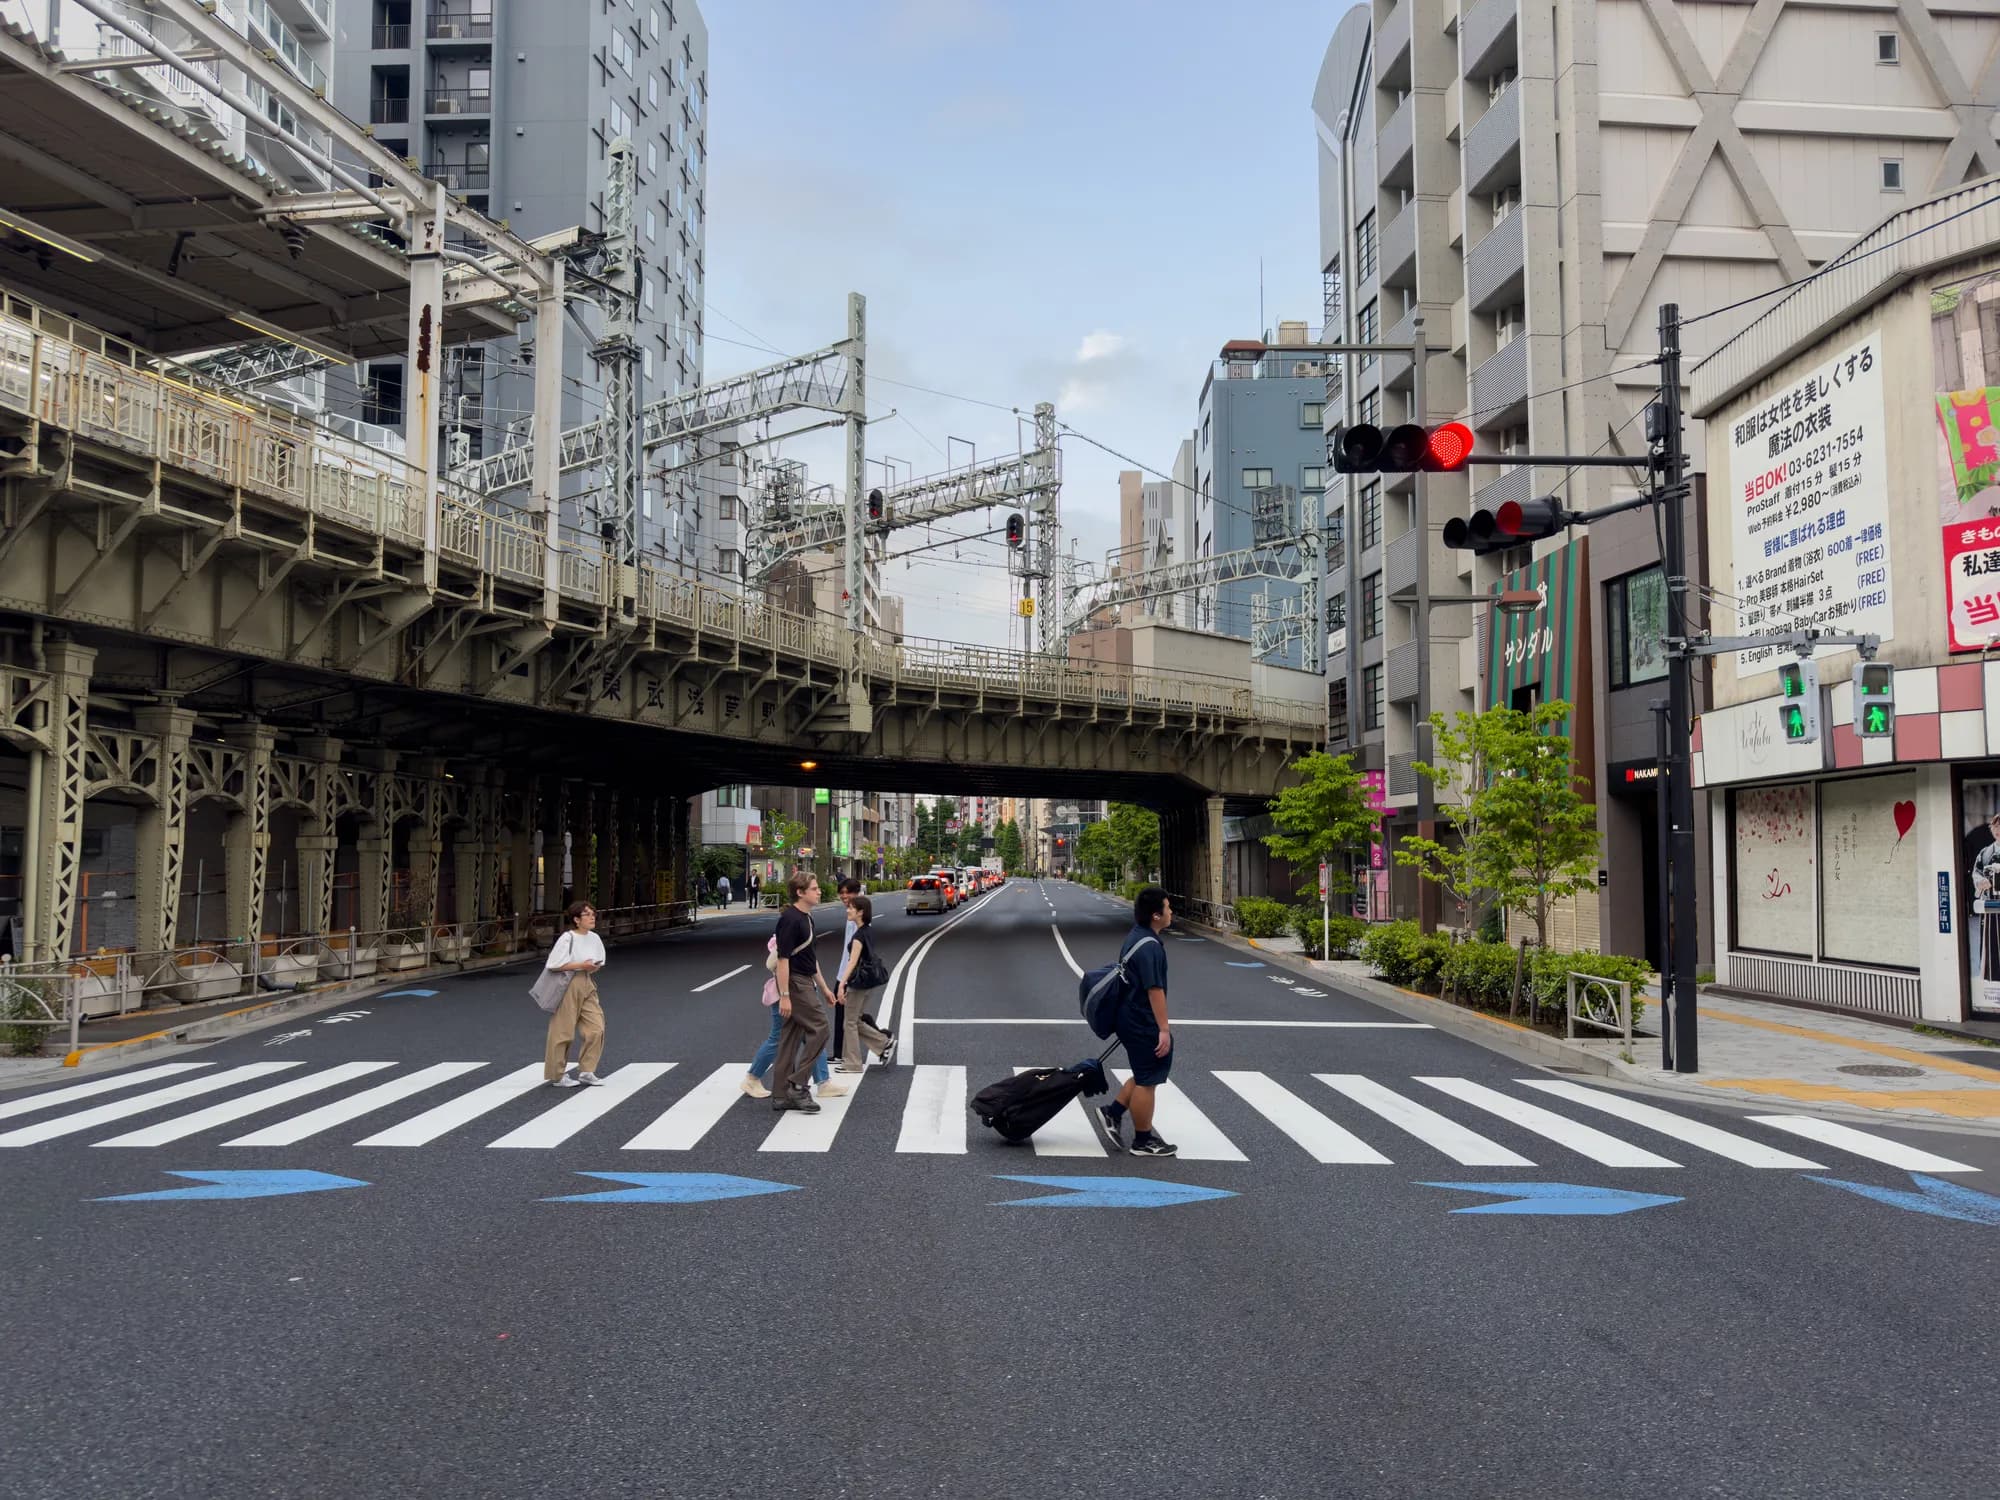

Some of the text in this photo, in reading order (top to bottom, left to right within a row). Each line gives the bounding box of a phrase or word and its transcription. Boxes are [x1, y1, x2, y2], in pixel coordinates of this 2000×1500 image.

[1735, 346, 1873, 448] 和服は女性を美しくする
[1768, 404, 1832, 459] 魔法の衣装
[1789, 425, 1864, 477] 03-6231-7554
[1747, 491, 1780, 517] ProStaff
[1764, 509, 1846, 558] 皆様に喜ばれる理由
[1857, 567, 1886, 590] (FREE)
[1858, 589, 1886, 611] (FREE)
[1505, 626, 1553, 667] サンダル
[1748, 647, 1773, 663] English
